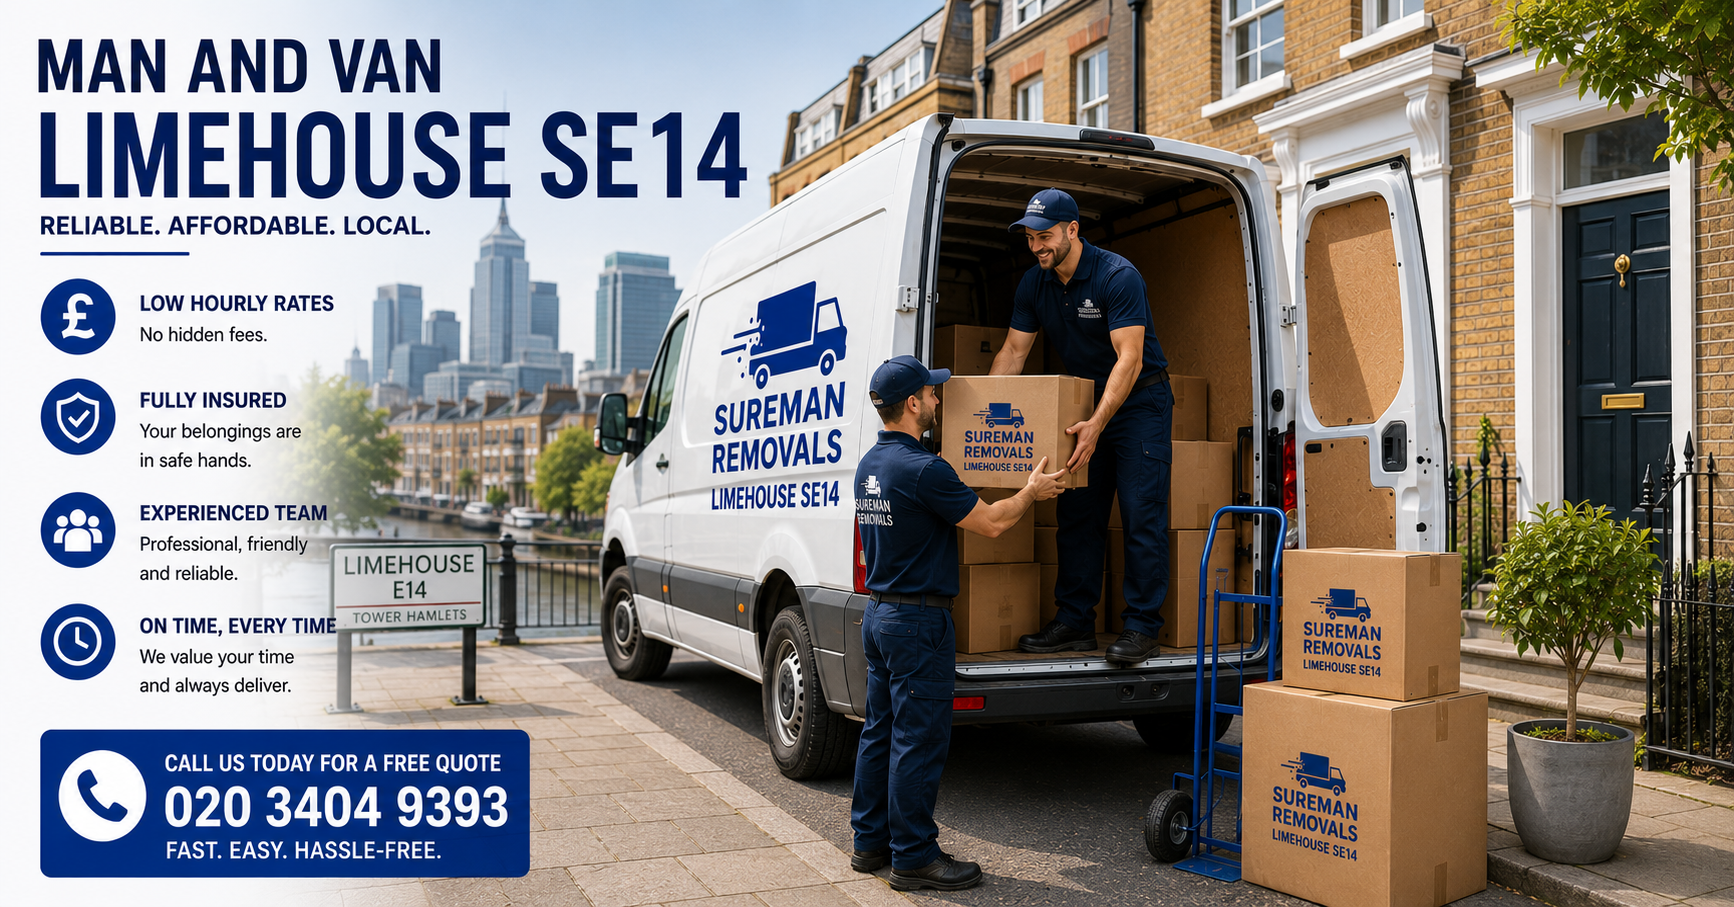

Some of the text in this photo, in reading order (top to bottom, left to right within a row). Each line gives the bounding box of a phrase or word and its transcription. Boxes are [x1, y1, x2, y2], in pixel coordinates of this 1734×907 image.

[713, 381, 846, 436] SUREMAN
[965, 430, 1034, 444] SUREMAN
[712, 429, 842, 474] REMOVALS
[964, 446, 1034, 459] REMOVALS
[964, 462, 1012, 472] LIMEHOUSE
[711, 481, 840, 510] LIMEHOUSE SE14
[344, 554, 475, 575] LIMEHOUSE
[393, 580, 427, 599] E14
[352, 608, 467, 625] TOWER HAMLETS
[1303, 621, 1381, 641] SUREMAN
[1304, 639, 1381, 660] REMOVALS
[1303, 659, 1381, 677] LIMEHOUSE SE14
[1273, 786, 1358, 821] SUREMAN
[1273, 805, 1358, 842] REMOVALS
[1272, 828, 1357, 861] LIMEHOUSE SE14
